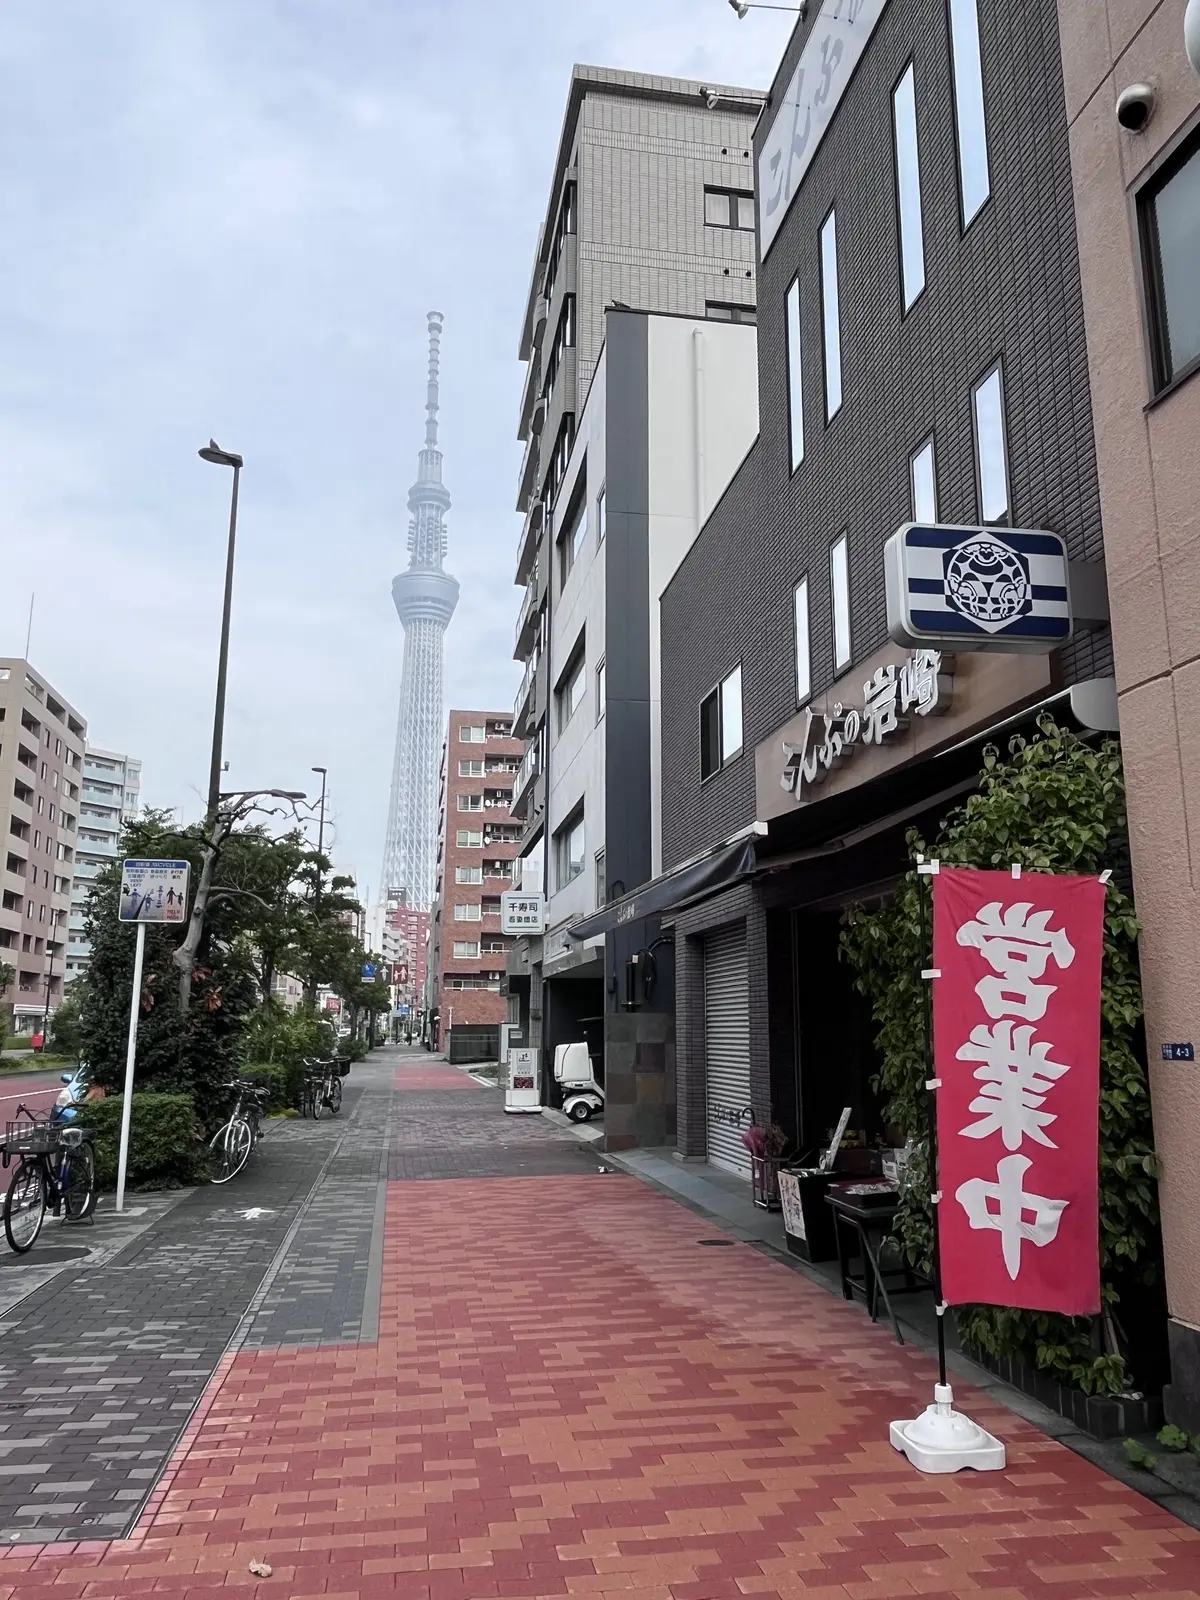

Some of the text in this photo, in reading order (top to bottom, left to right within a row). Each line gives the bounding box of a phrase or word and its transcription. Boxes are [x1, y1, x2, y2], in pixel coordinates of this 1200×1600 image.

[508, 902, 538, 912] 千寿司
[955, 902, 1076, 1281] 営業中
